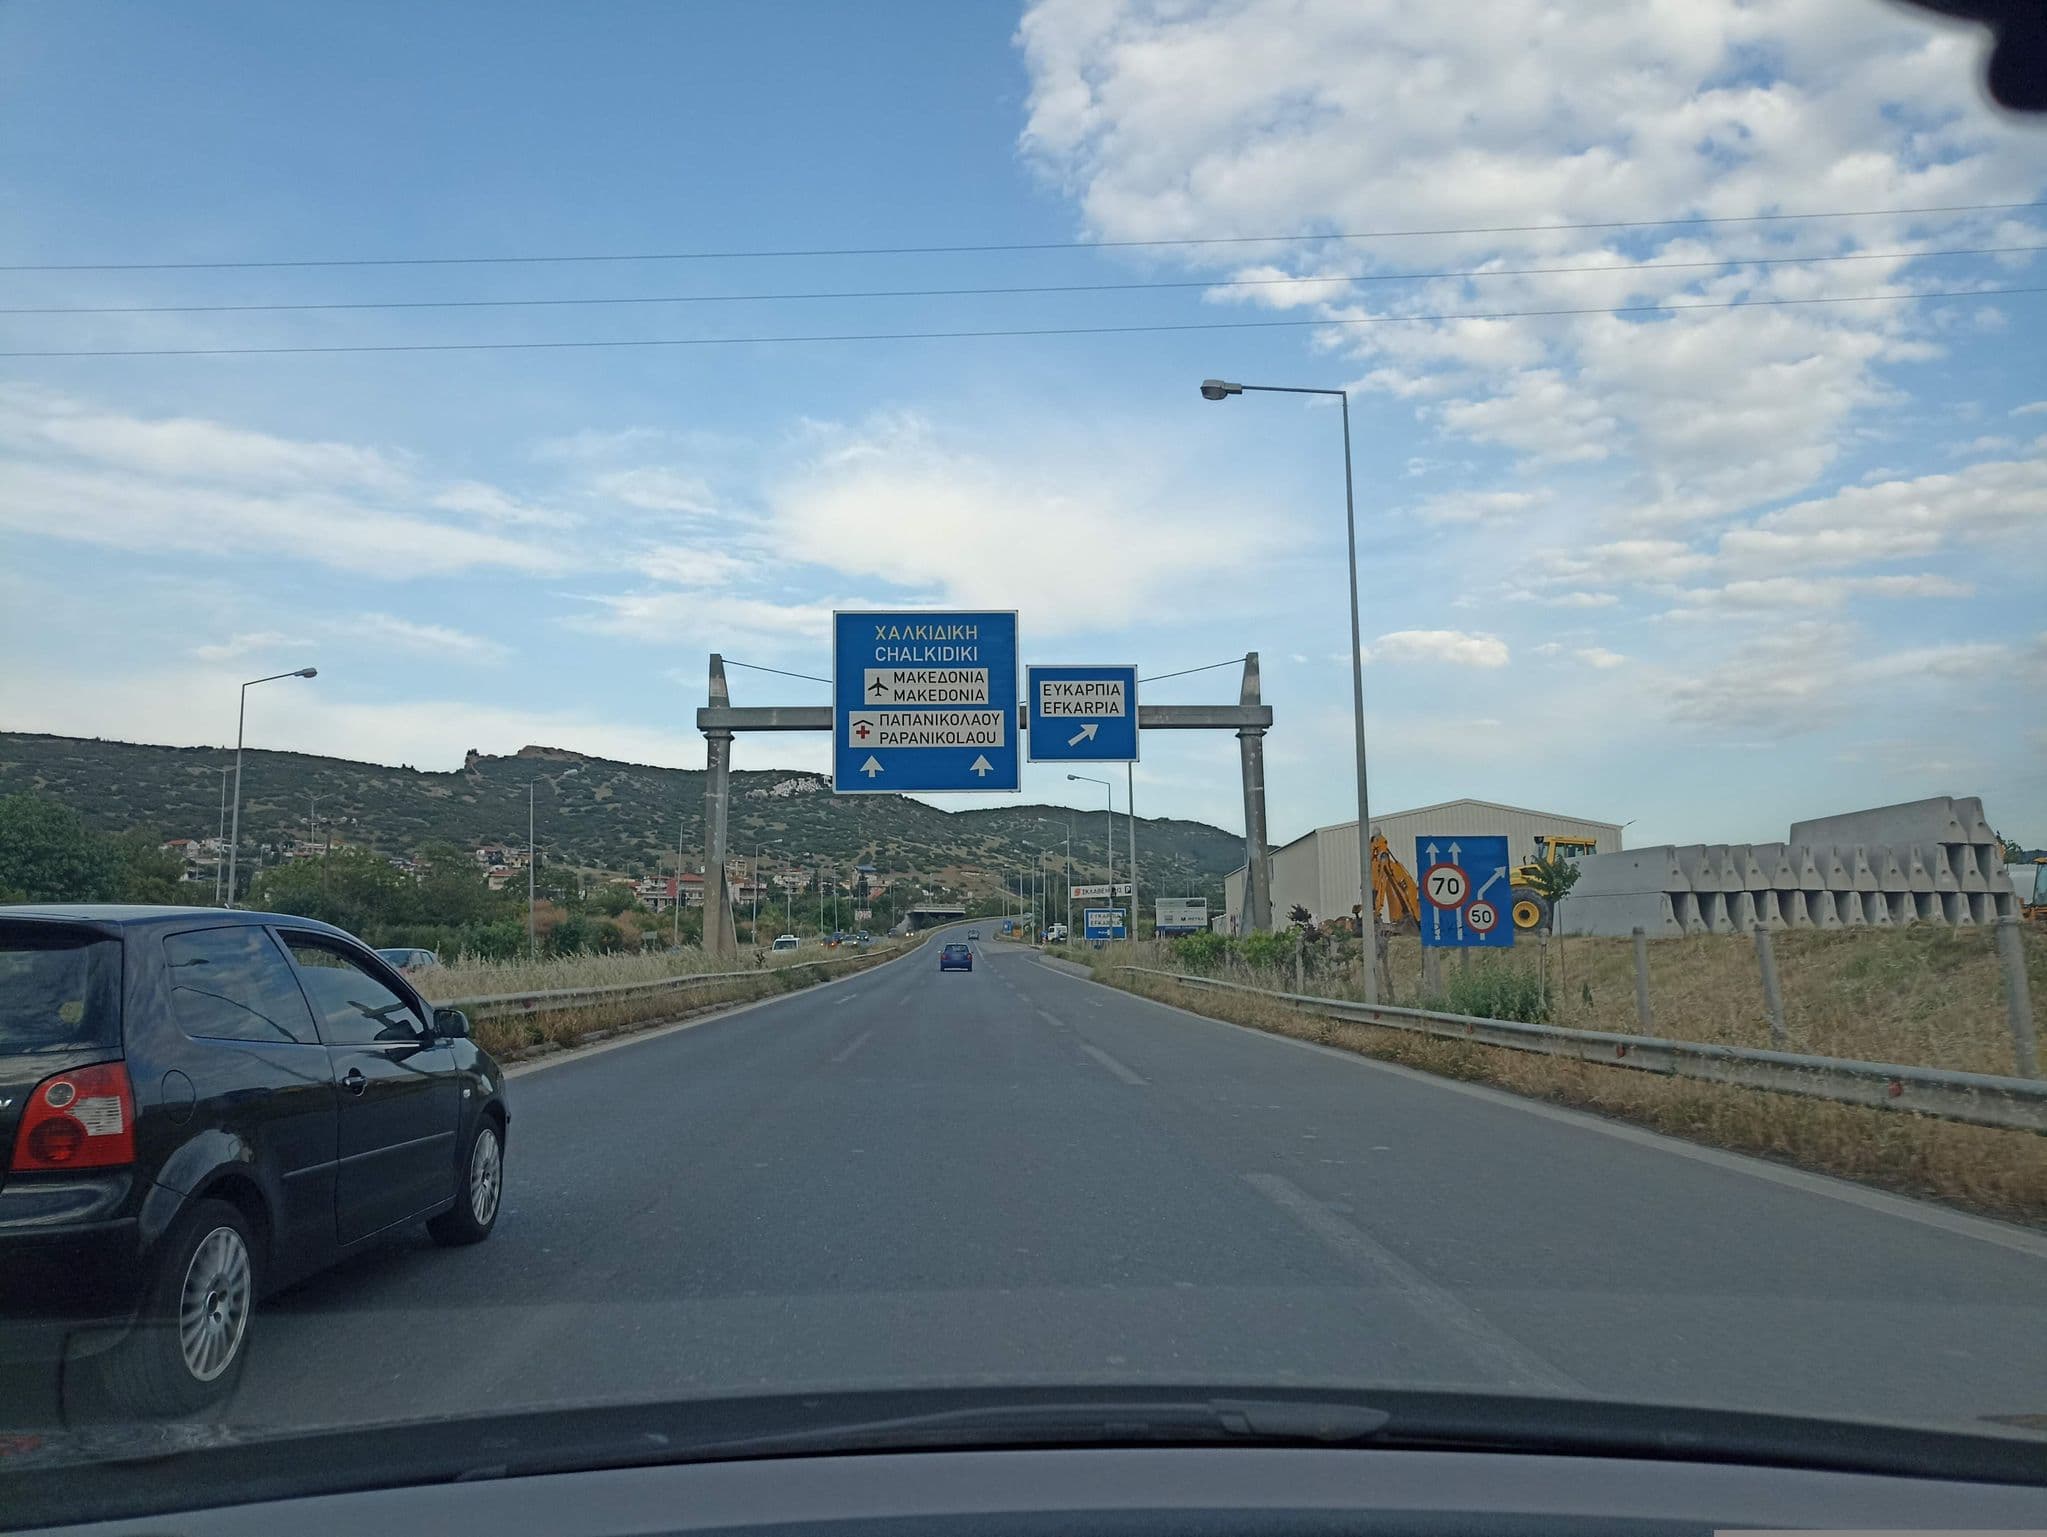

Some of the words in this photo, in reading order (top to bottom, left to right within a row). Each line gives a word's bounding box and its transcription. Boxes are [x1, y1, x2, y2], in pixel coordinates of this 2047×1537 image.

[875, 625, 978, 640] ΧΑΛΚΙΔΙΚΗ
[875, 646, 978, 662] CHALKIDIKI
[894, 671, 985, 684] ΜΑΚΕΔΟΝΙΑ
[894, 689, 985, 702] MAKEDONIA
[1043, 683, 1121, 696] ΕΥΚΑΡΠΙΑ
[1043, 701, 1120, 714] EFKARPIA
[879, 713, 1000, 726] ΠΑΠΑΝΙΚΟΛΑΟΥ
[879, 731, 996, 745] PAPANIKOLAOU
[1432, 877, 1459, 895] 70
[1471, 910, 1492, 923] 50
